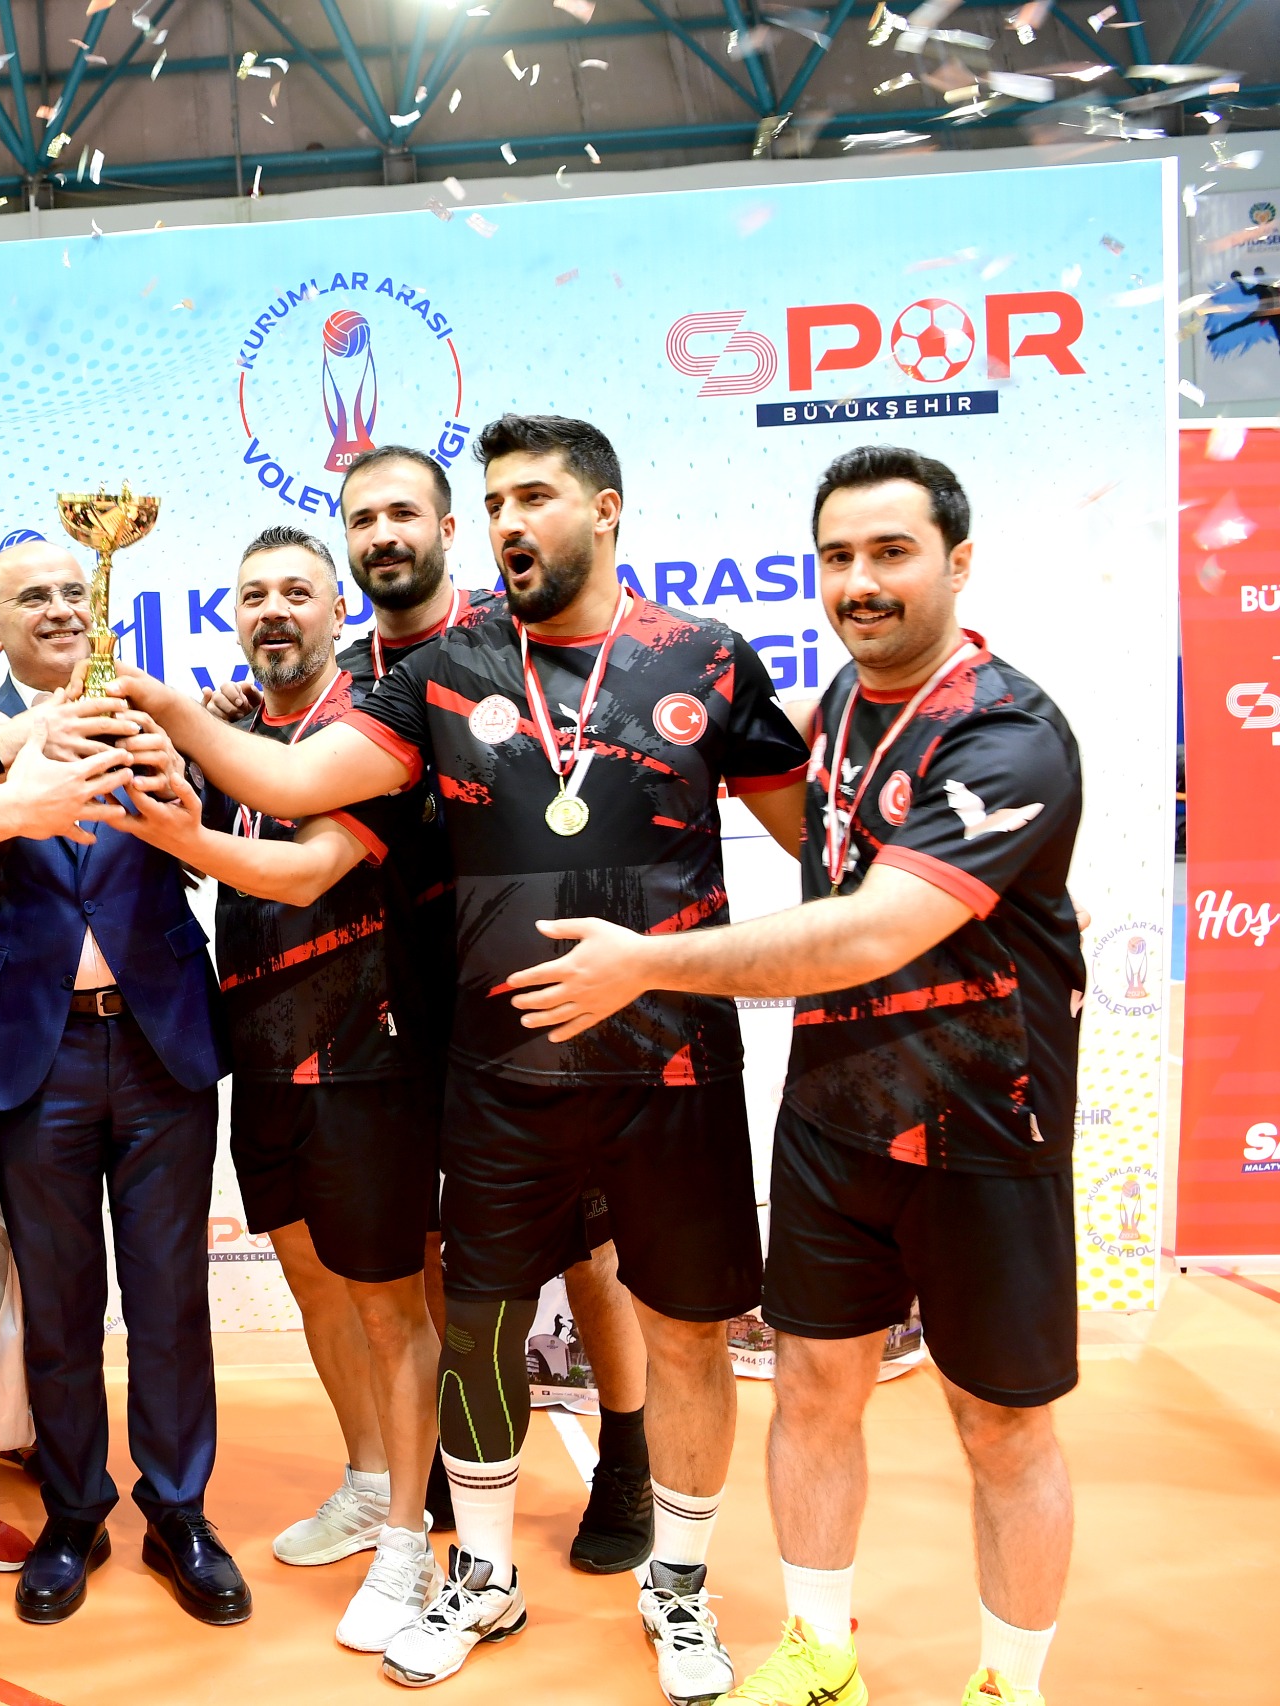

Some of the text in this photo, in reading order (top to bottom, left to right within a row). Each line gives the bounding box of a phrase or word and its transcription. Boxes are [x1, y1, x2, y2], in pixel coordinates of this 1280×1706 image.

[237, 272, 454, 370] KURUMLAR ARASI
[666, 290, 1087, 398] SPOR
[783, 395, 973, 423] BÜYÜKŞEHİR
[559, 724, 599, 735] verex
[1194, 889, 1280, 947] Hoş
[1092, 921, 1147, 958] KURUMLAR
[1092, 984, 1162, 1017] VOLEYBOL
[1243, 1122, 1280, 1161] S
[1087, 1166, 1141, 1201] KURUMLAR
[1086, 1226, 1155, 1258] VOLEYBOL
